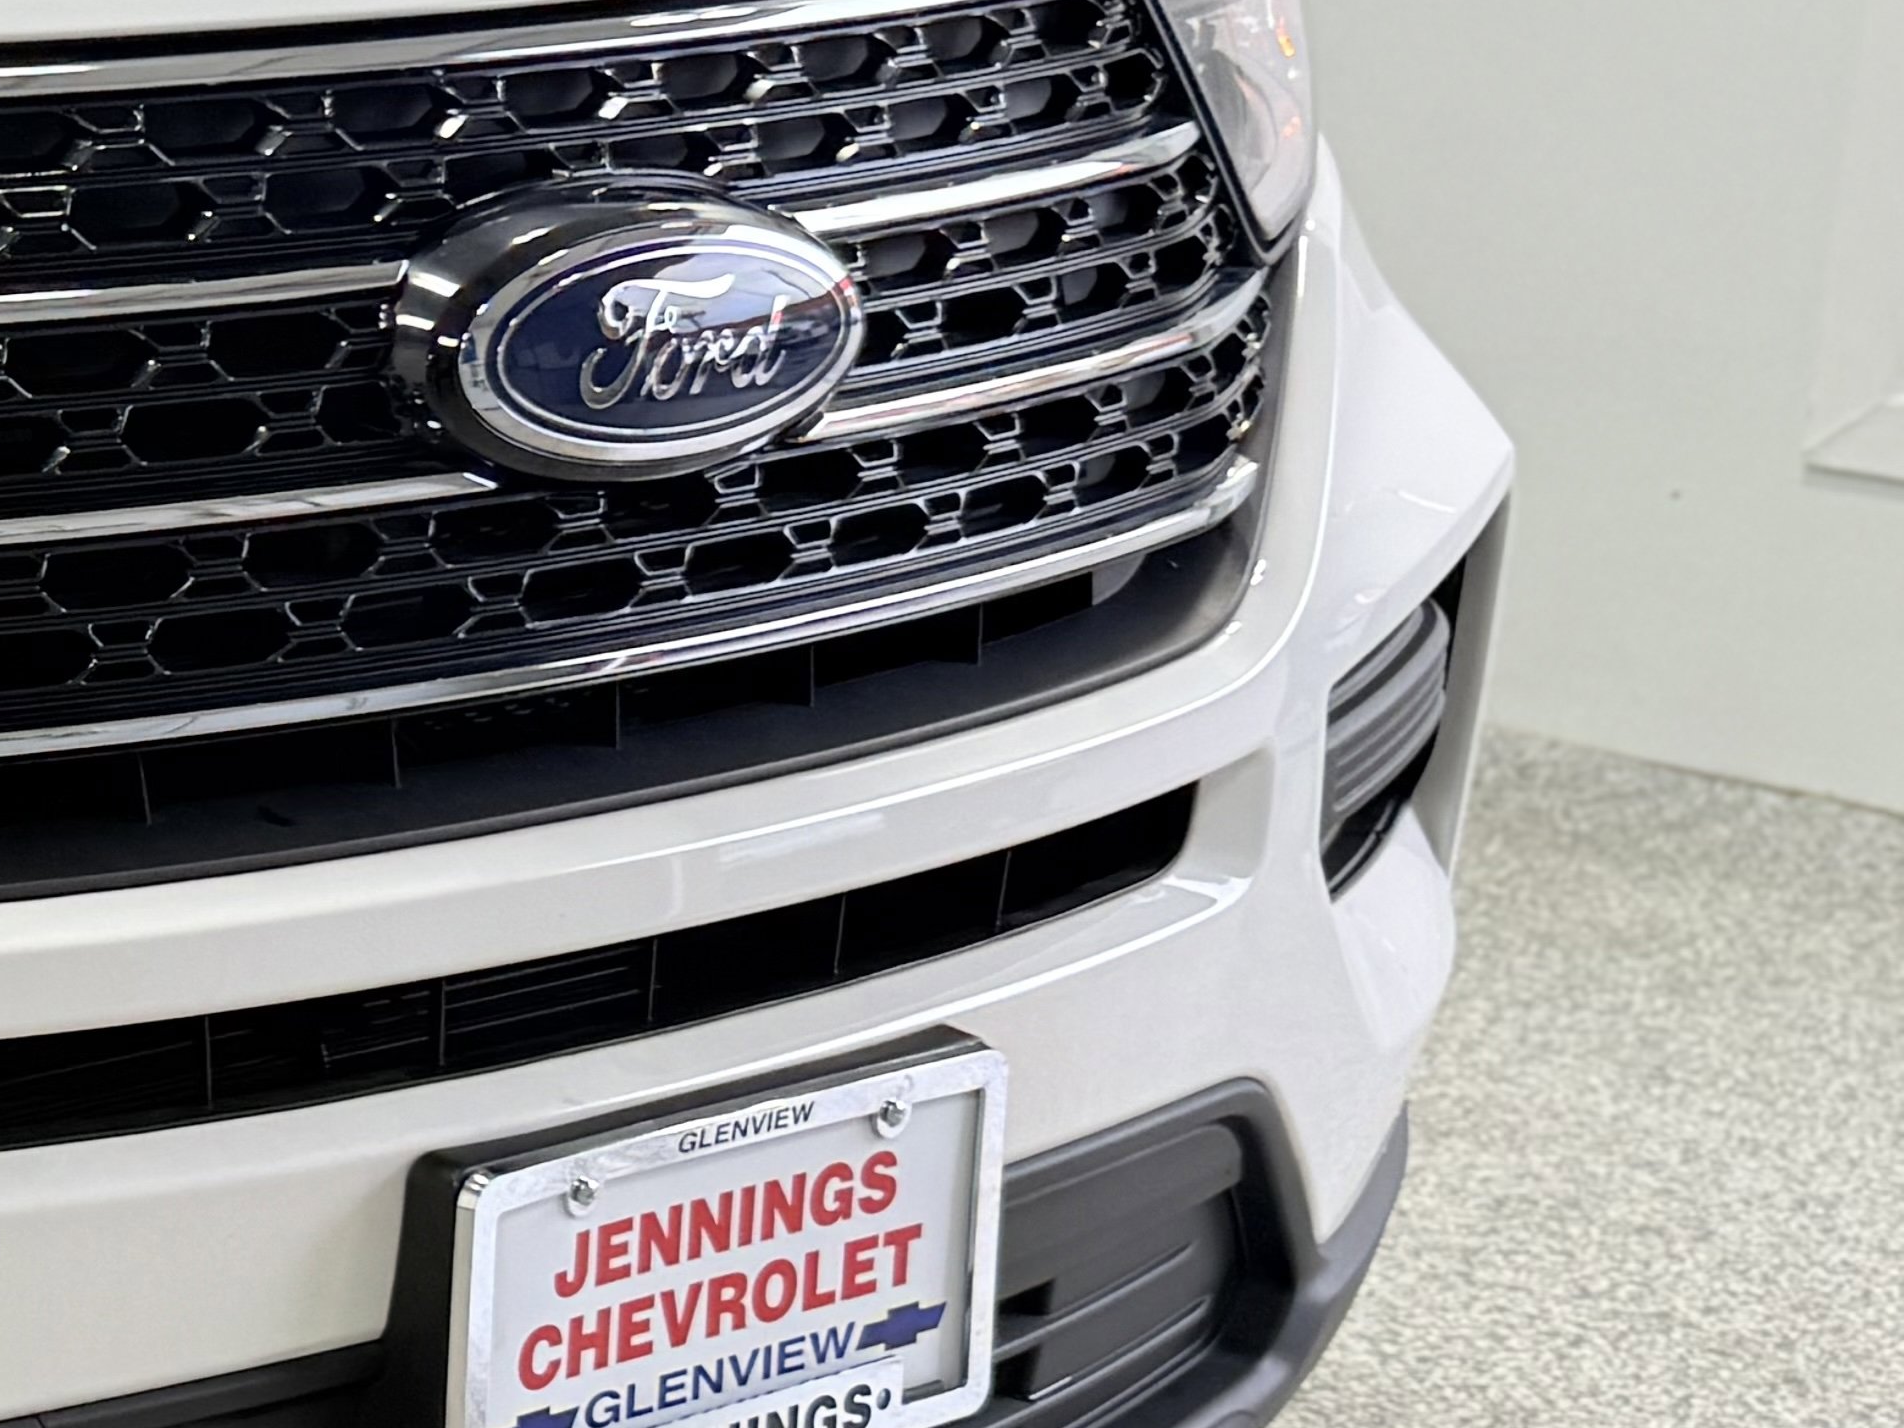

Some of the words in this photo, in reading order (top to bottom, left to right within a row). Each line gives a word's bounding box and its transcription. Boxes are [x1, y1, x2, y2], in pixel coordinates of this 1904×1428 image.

[579, 273, 789, 410] Ford
[677, 1100, 816, 1156] GLENVIEW
[553, 1150, 899, 1299] JENNINGS
[517, 1223, 923, 1391] CHEVROLET
